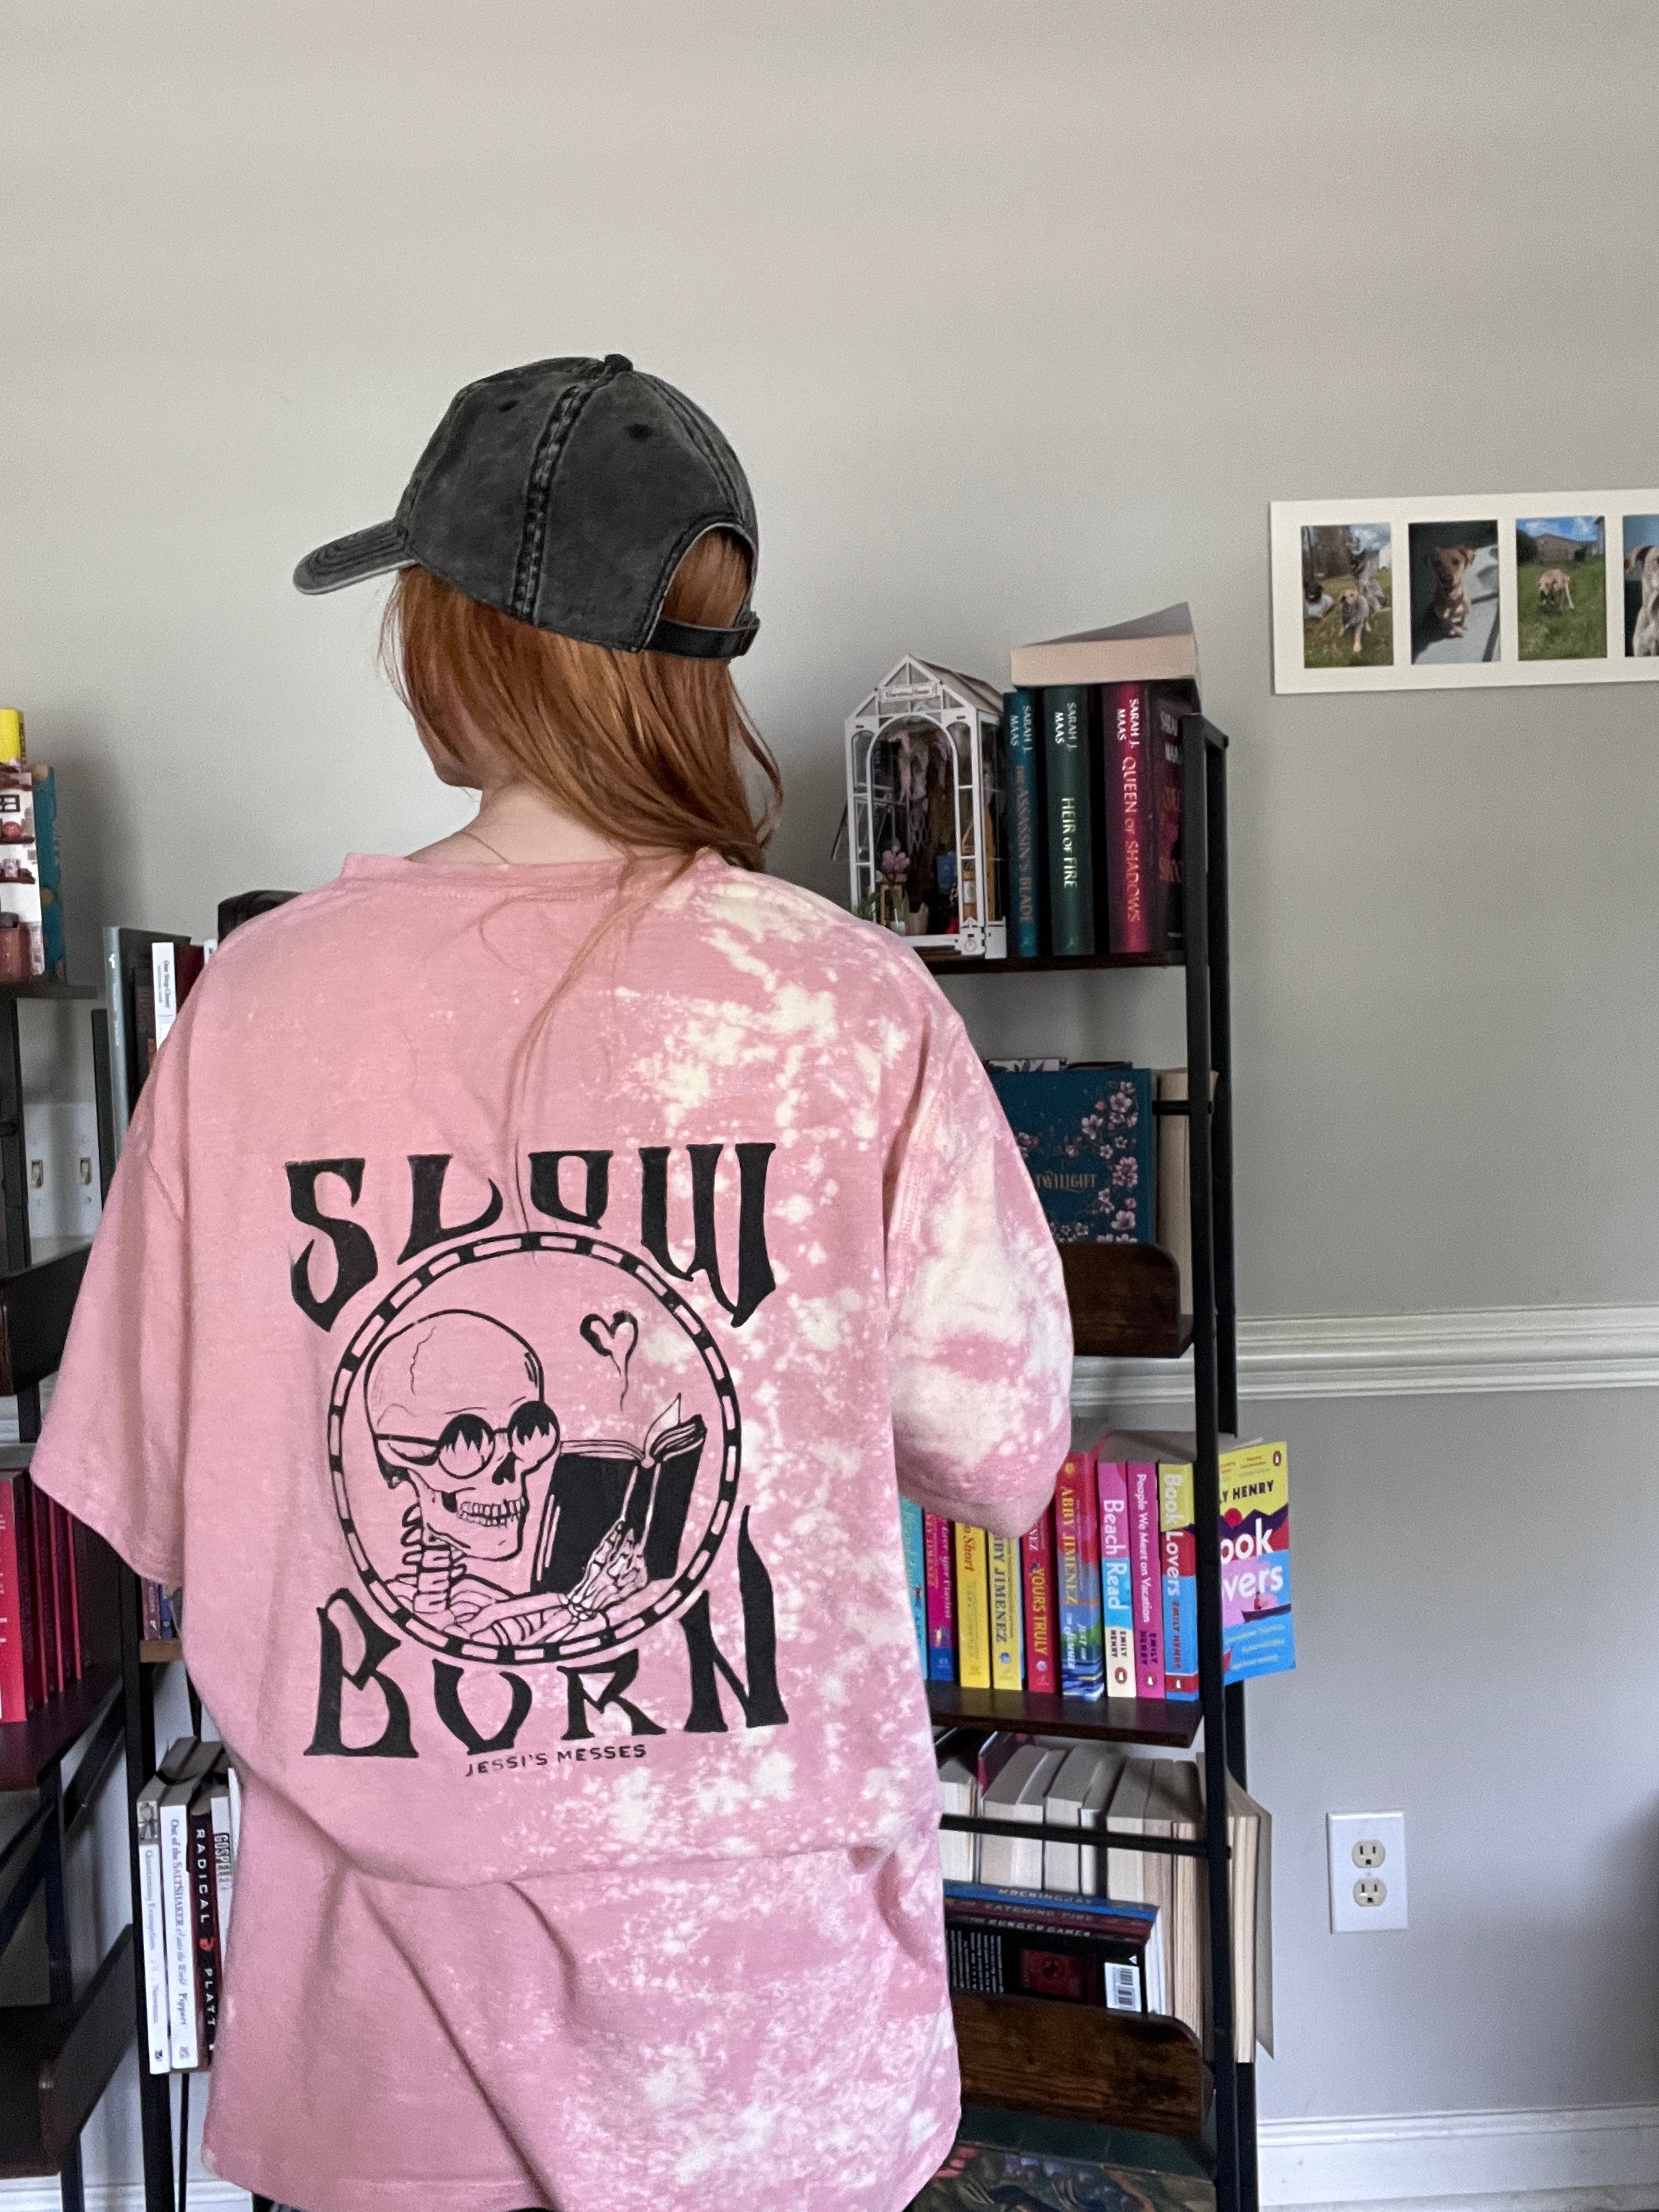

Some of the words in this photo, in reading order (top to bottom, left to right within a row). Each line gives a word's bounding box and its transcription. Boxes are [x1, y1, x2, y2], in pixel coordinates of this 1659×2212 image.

[1010, 715, 1019, 746] MAAS
[1022, 705, 1032, 741] SARAH
[1054, 711, 1064, 744] MAAS
[1067, 702, 1077, 740] SARAH
[1116, 708, 1126, 740] MAAS
[1130, 698, 1139, 736] SARAH
[1067, 744, 1077, 753] J.
[1130, 741, 1140, 749] J.
[1122, 756, 1138, 813] QUEEN
[1062, 797, 1075, 834] HEIR
[1064, 857, 1077, 888] FIRE
[1125, 840, 1140, 923] SHADOWS
[1019, 876, 1033, 925] BLADE
[285, 1143, 776, 1331] SLOW
[1061, 1486, 1076, 1527] ABBY
[1135, 1473, 1148, 1510] People
[1164, 1473, 1183, 1524] Book
[1232, 1480, 1274, 1501] HENRY
[1103, 1499, 1125, 1555] Beach
[1138, 1513, 1148, 1529] We
[963, 1536, 975, 1572] Short
[994, 1538, 1004, 1562] BY
[1138, 1531, 1149, 1559] Meet
[1221, 1518, 1274, 1564] ook
[1062, 1532, 1077, 1605] JIMENEZ
[1140, 1562, 1148, 1576] on
[1165, 1531, 1184, 1596] Lovers
[1032, 1568, 1047, 1612] YOURS
[1106, 1562, 1127, 1610] Read
[1140, 1577, 1152, 1622] Vacation
[1222, 1565, 1283, 1602] vers
[995, 1568, 1007, 1643] JIMENEZ
[304, 1506, 789, 1758] BURN
[1034, 1616, 1048, 1655] TRULY
[1110, 1630, 1118, 1658] HENRY
[466, 1753, 548, 1776] JESSI'S
[557, 1744, 646, 1763] MESSES
[170, 1819, 180, 1836] Out
[172, 1837, 181, 1847] of
[172, 1848, 181, 1861] the
[196, 1829, 211, 1923] RADICAL
[176, 1993, 188, 2026] Pippert
[204, 1968, 216, 2026] PLATT
